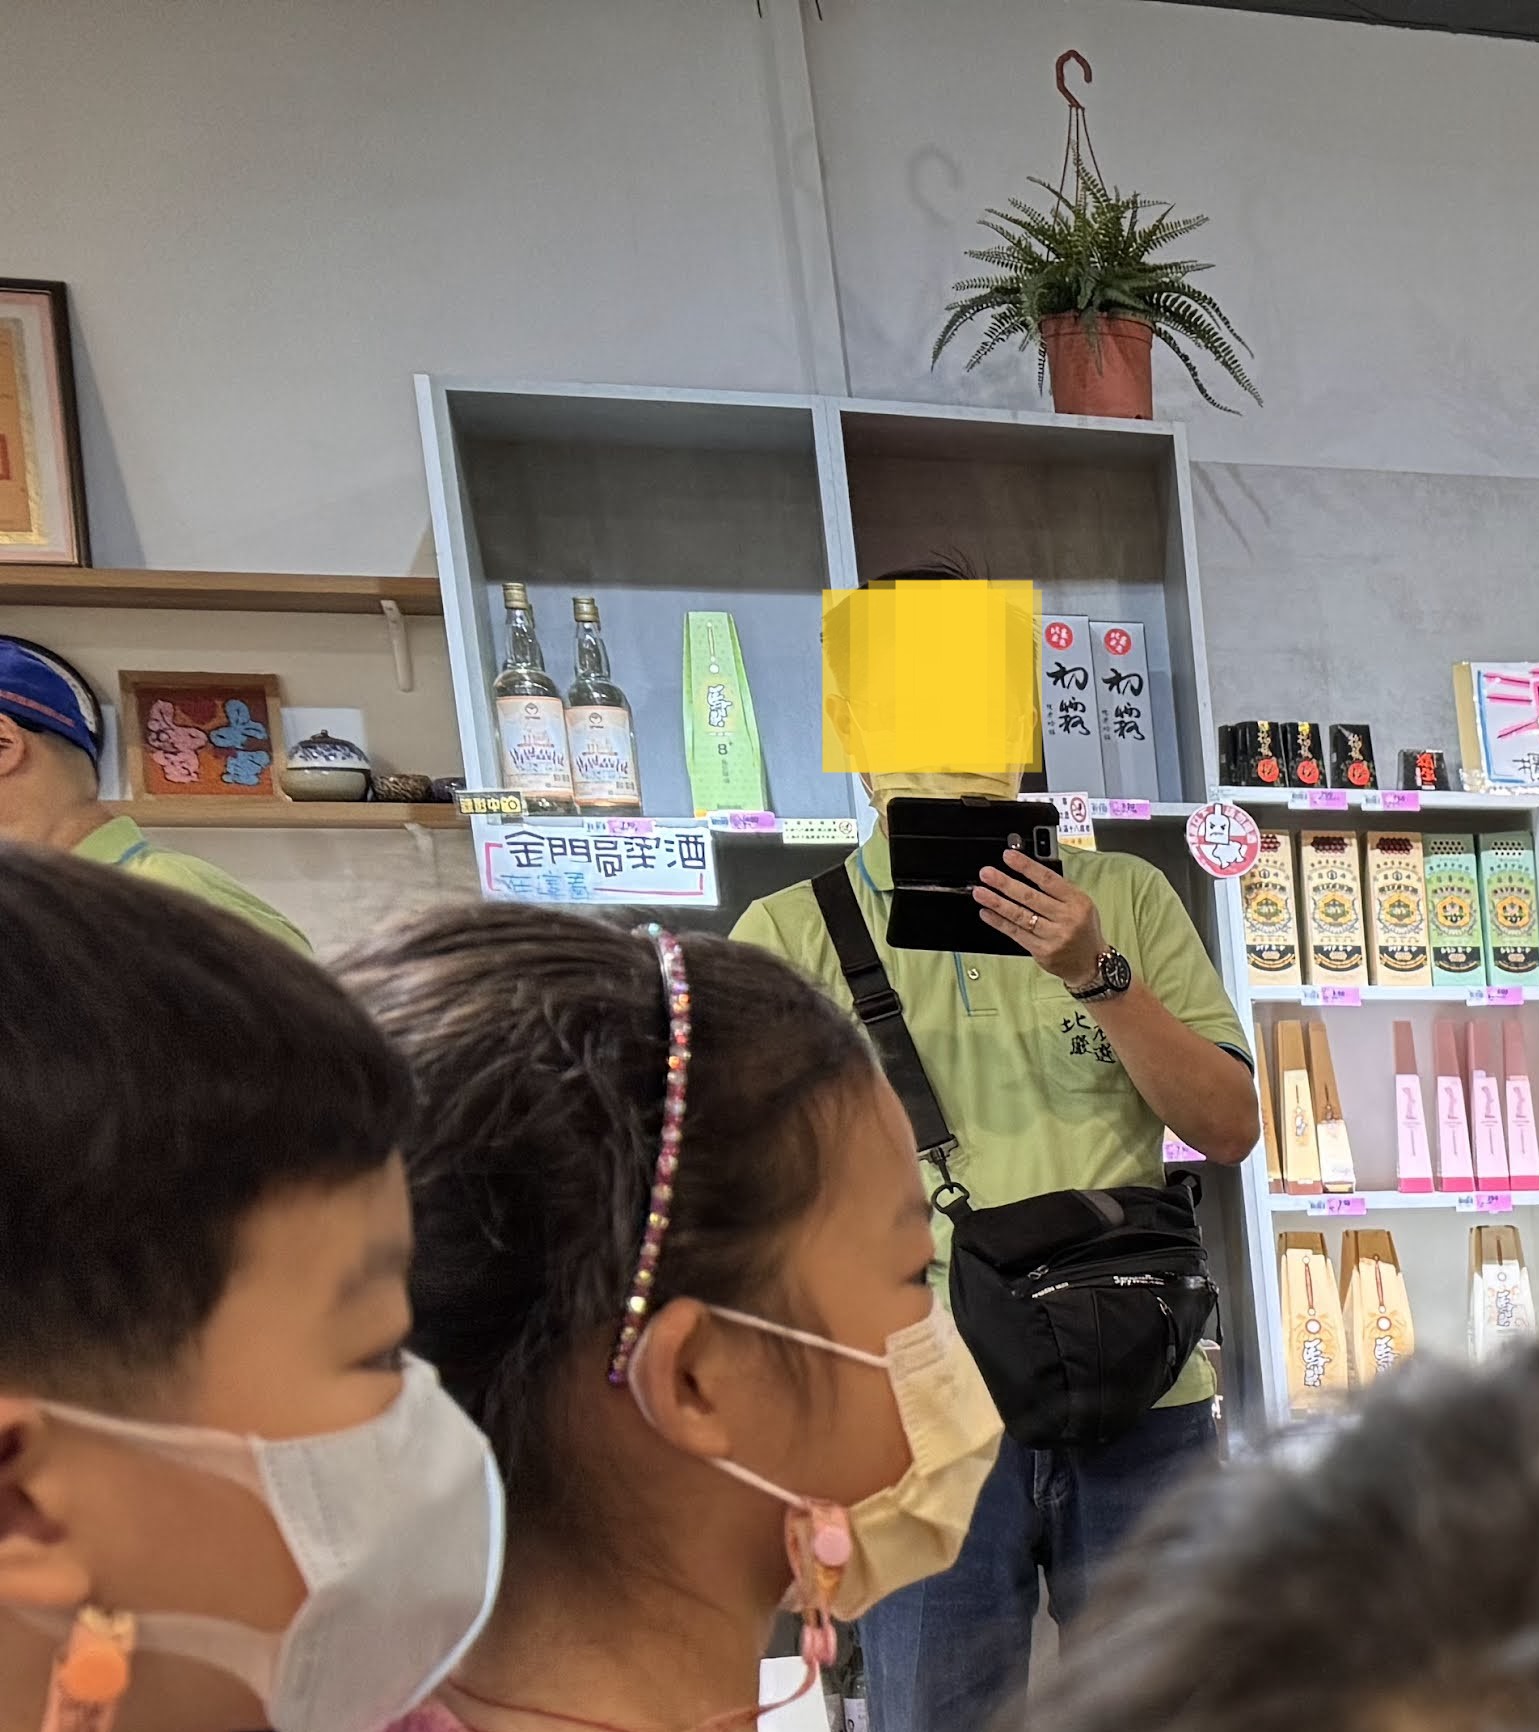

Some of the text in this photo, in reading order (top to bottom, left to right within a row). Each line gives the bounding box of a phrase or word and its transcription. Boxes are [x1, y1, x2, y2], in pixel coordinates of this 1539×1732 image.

[503, 831, 706, 877] 金門高粱酒
